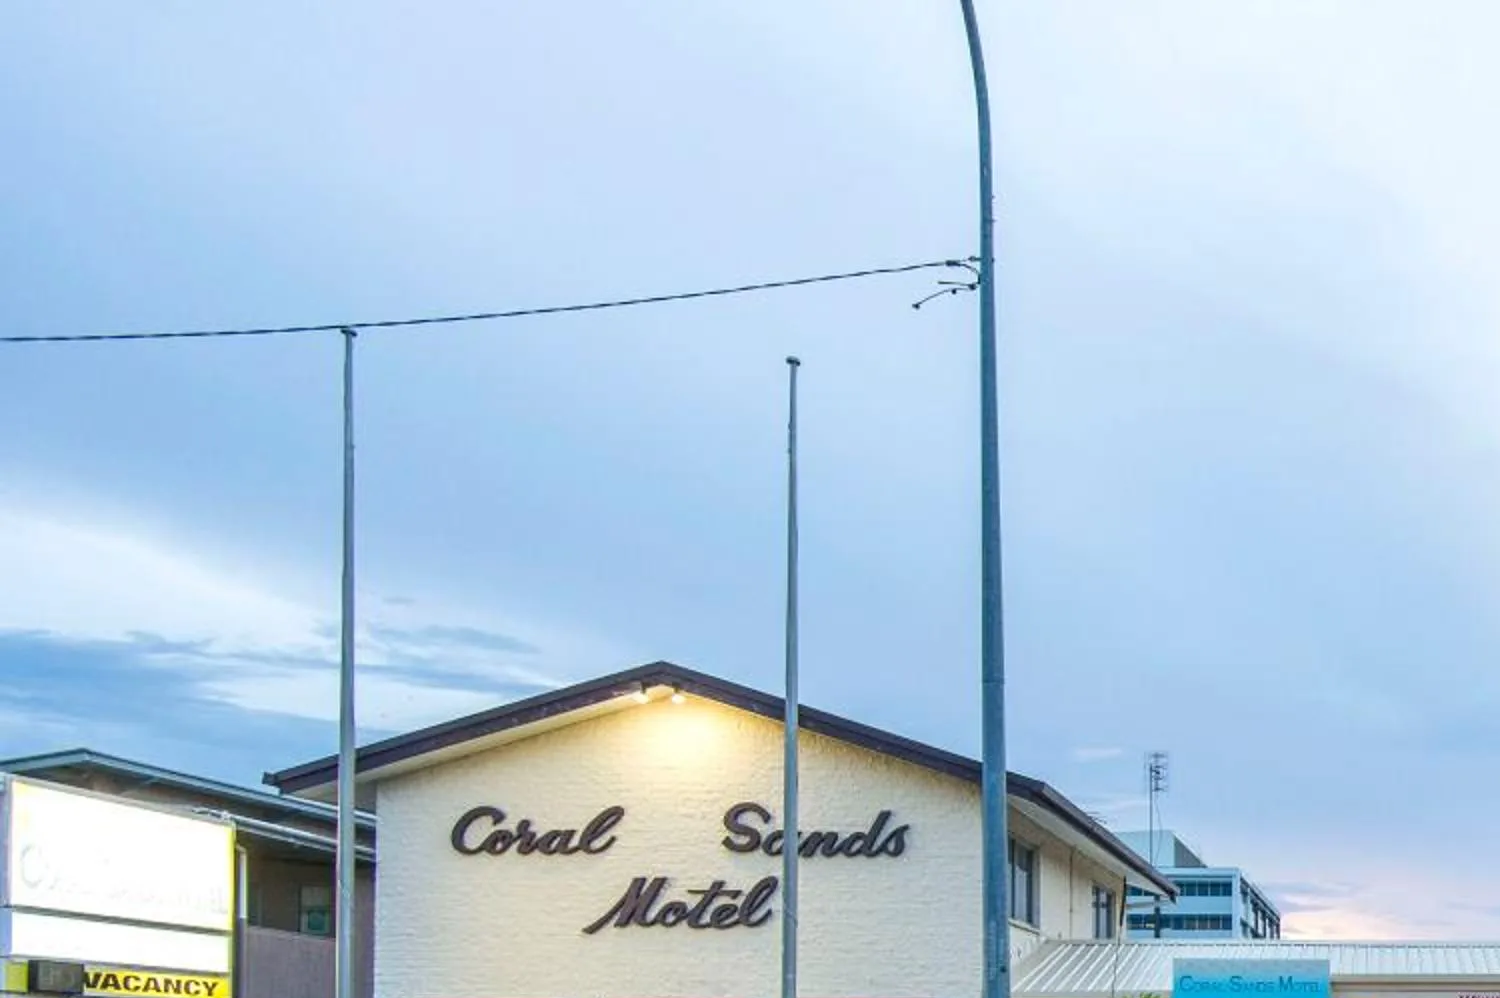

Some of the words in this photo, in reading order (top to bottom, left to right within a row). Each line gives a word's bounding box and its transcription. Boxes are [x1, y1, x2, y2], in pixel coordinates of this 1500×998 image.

[450, 805, 625, 856] Coral
[721, 801, 910, 858] Sands
[582, 876, 778, 934] Motel
[84, 971, 219, 997] VACANCY
